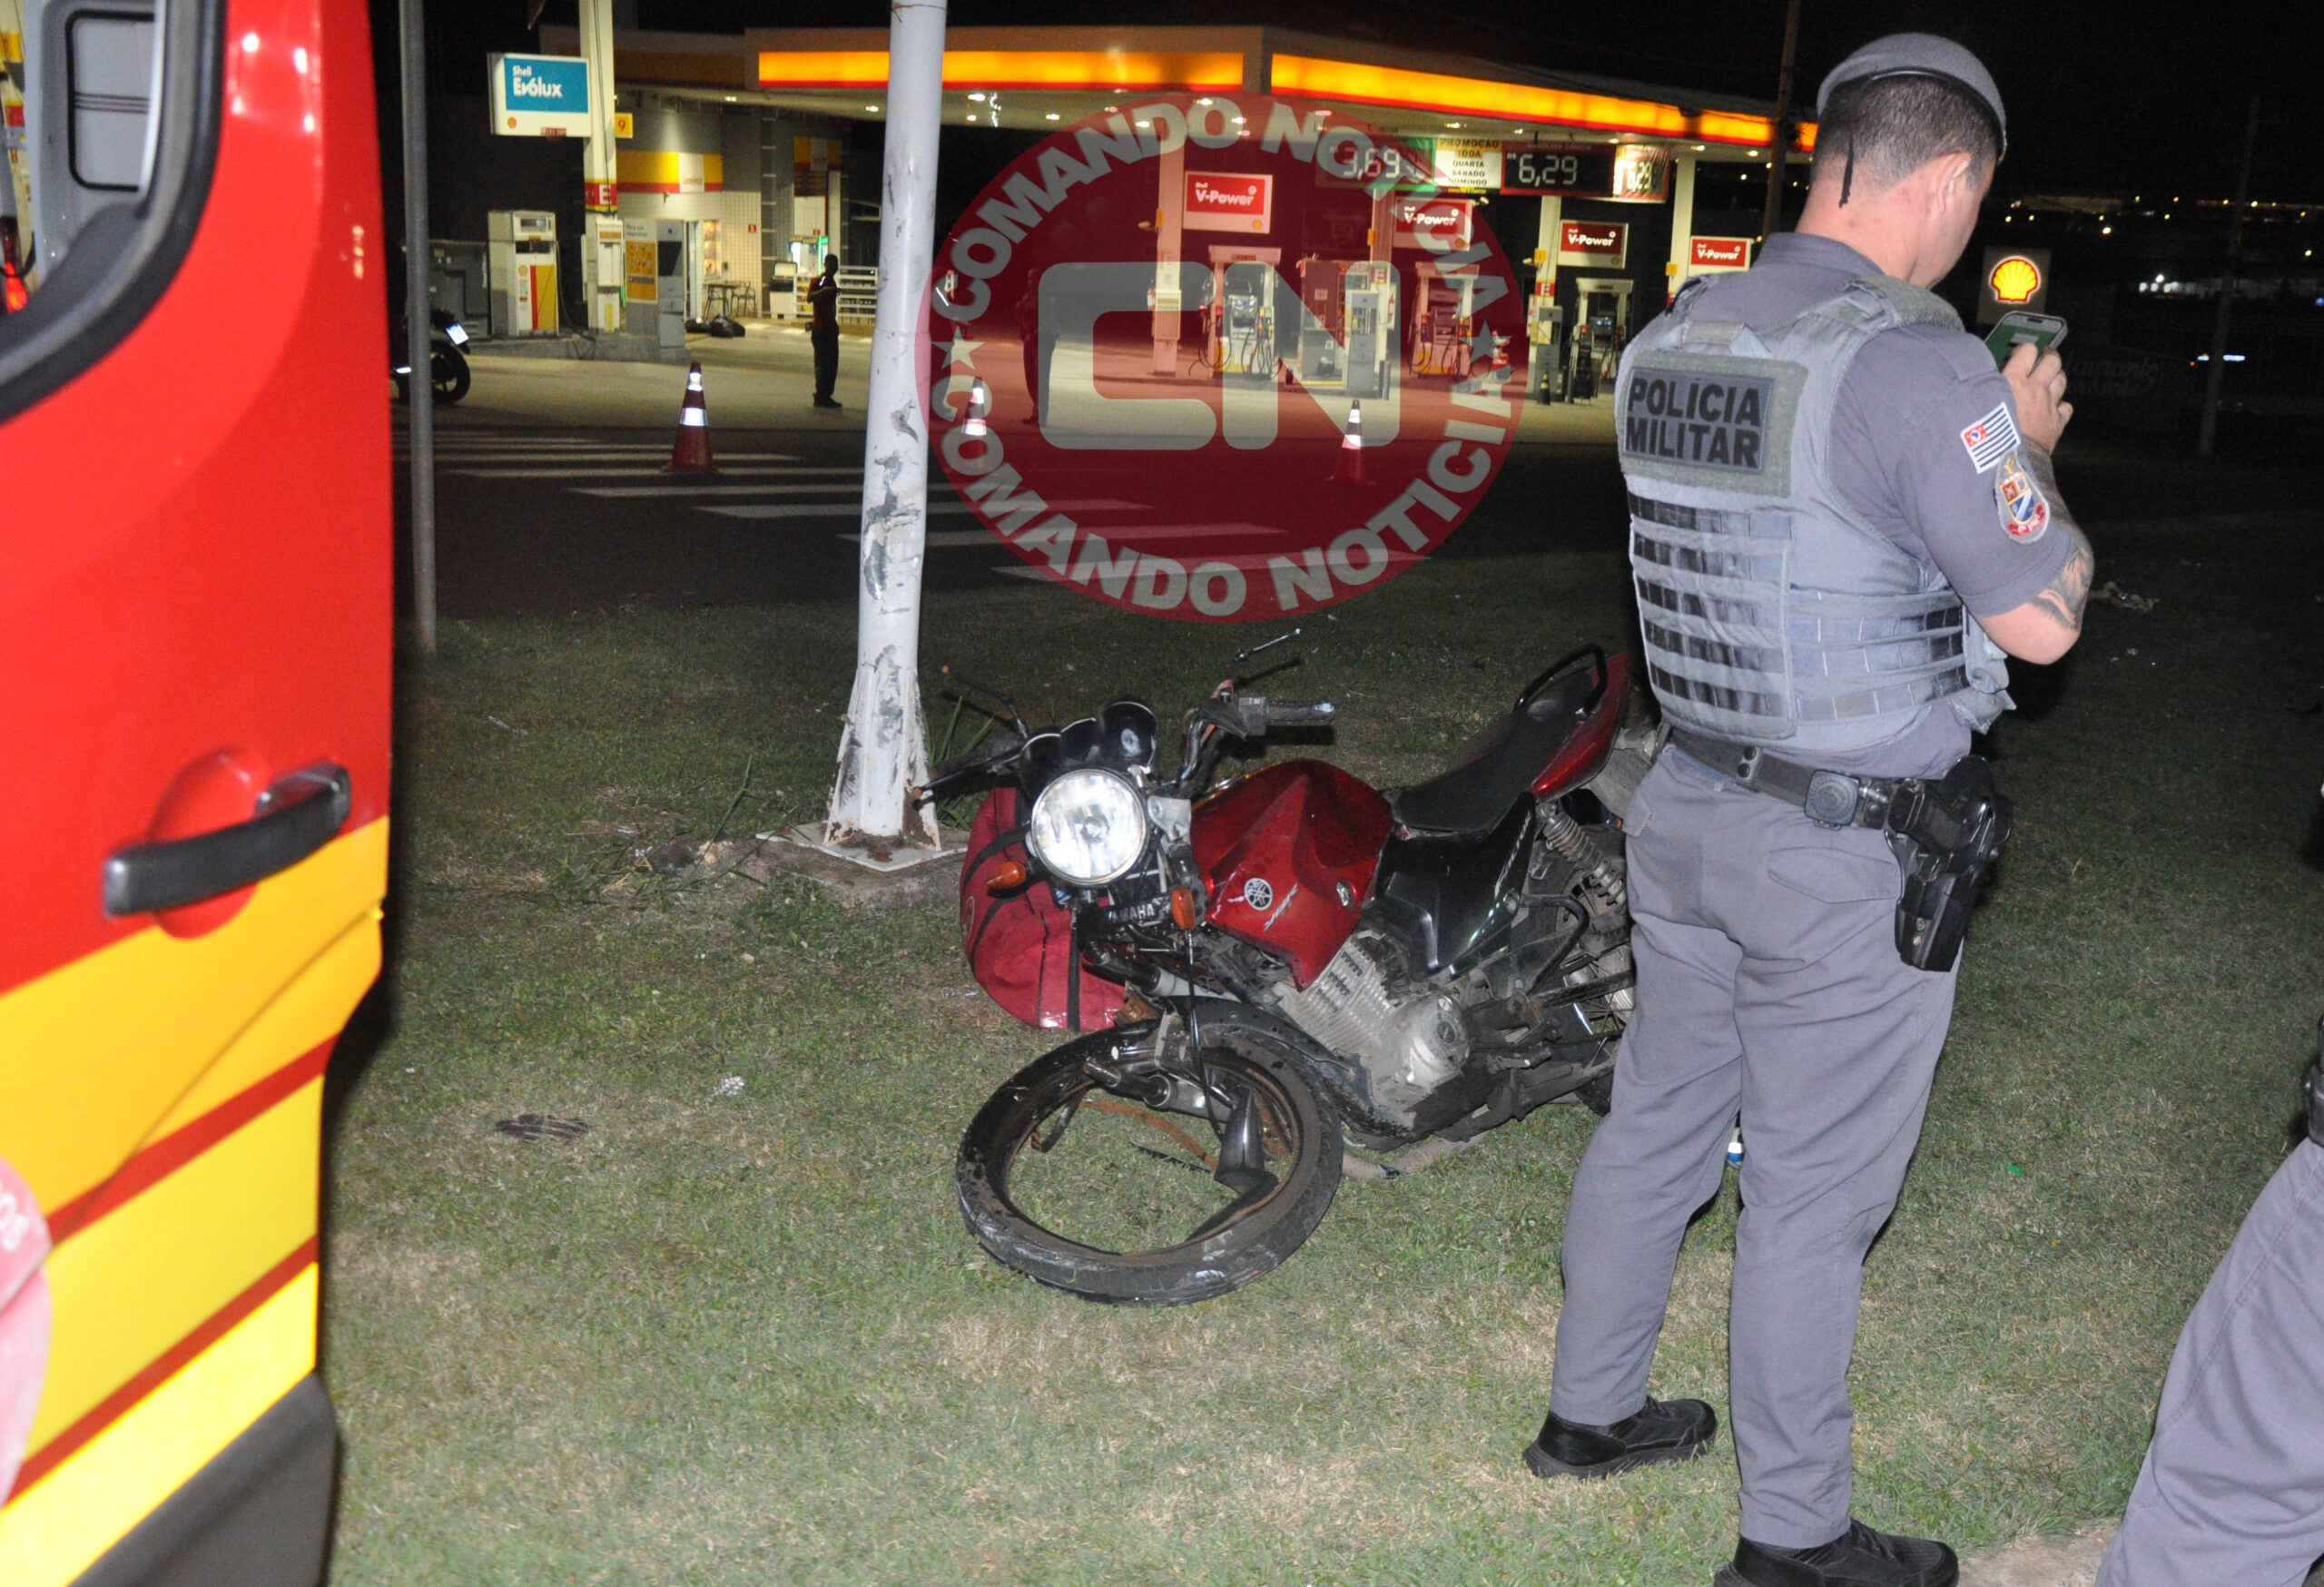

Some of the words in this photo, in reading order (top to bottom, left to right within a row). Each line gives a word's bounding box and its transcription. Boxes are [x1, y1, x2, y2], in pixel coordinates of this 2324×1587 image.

[513, 65, 532, 77] Shell
[1457, 150, 1482, 158] TODA
[1343, 147, 1400, 180] 3,69
[1452, 160, 1484, 168] QUARTA
[1518, 153, 1578, 189] 6,29
[1196, 189, 1255, 206] V-Power
[1403, 212, 1456, 225] V-Power
[1568, 233, 1614, 246] V-Power
[1697, 248, 1739, 261] V-Power
[1628, 378, 1760, 426] POLÍCIA
[1626, 416, 1760, 467] MILITAR
